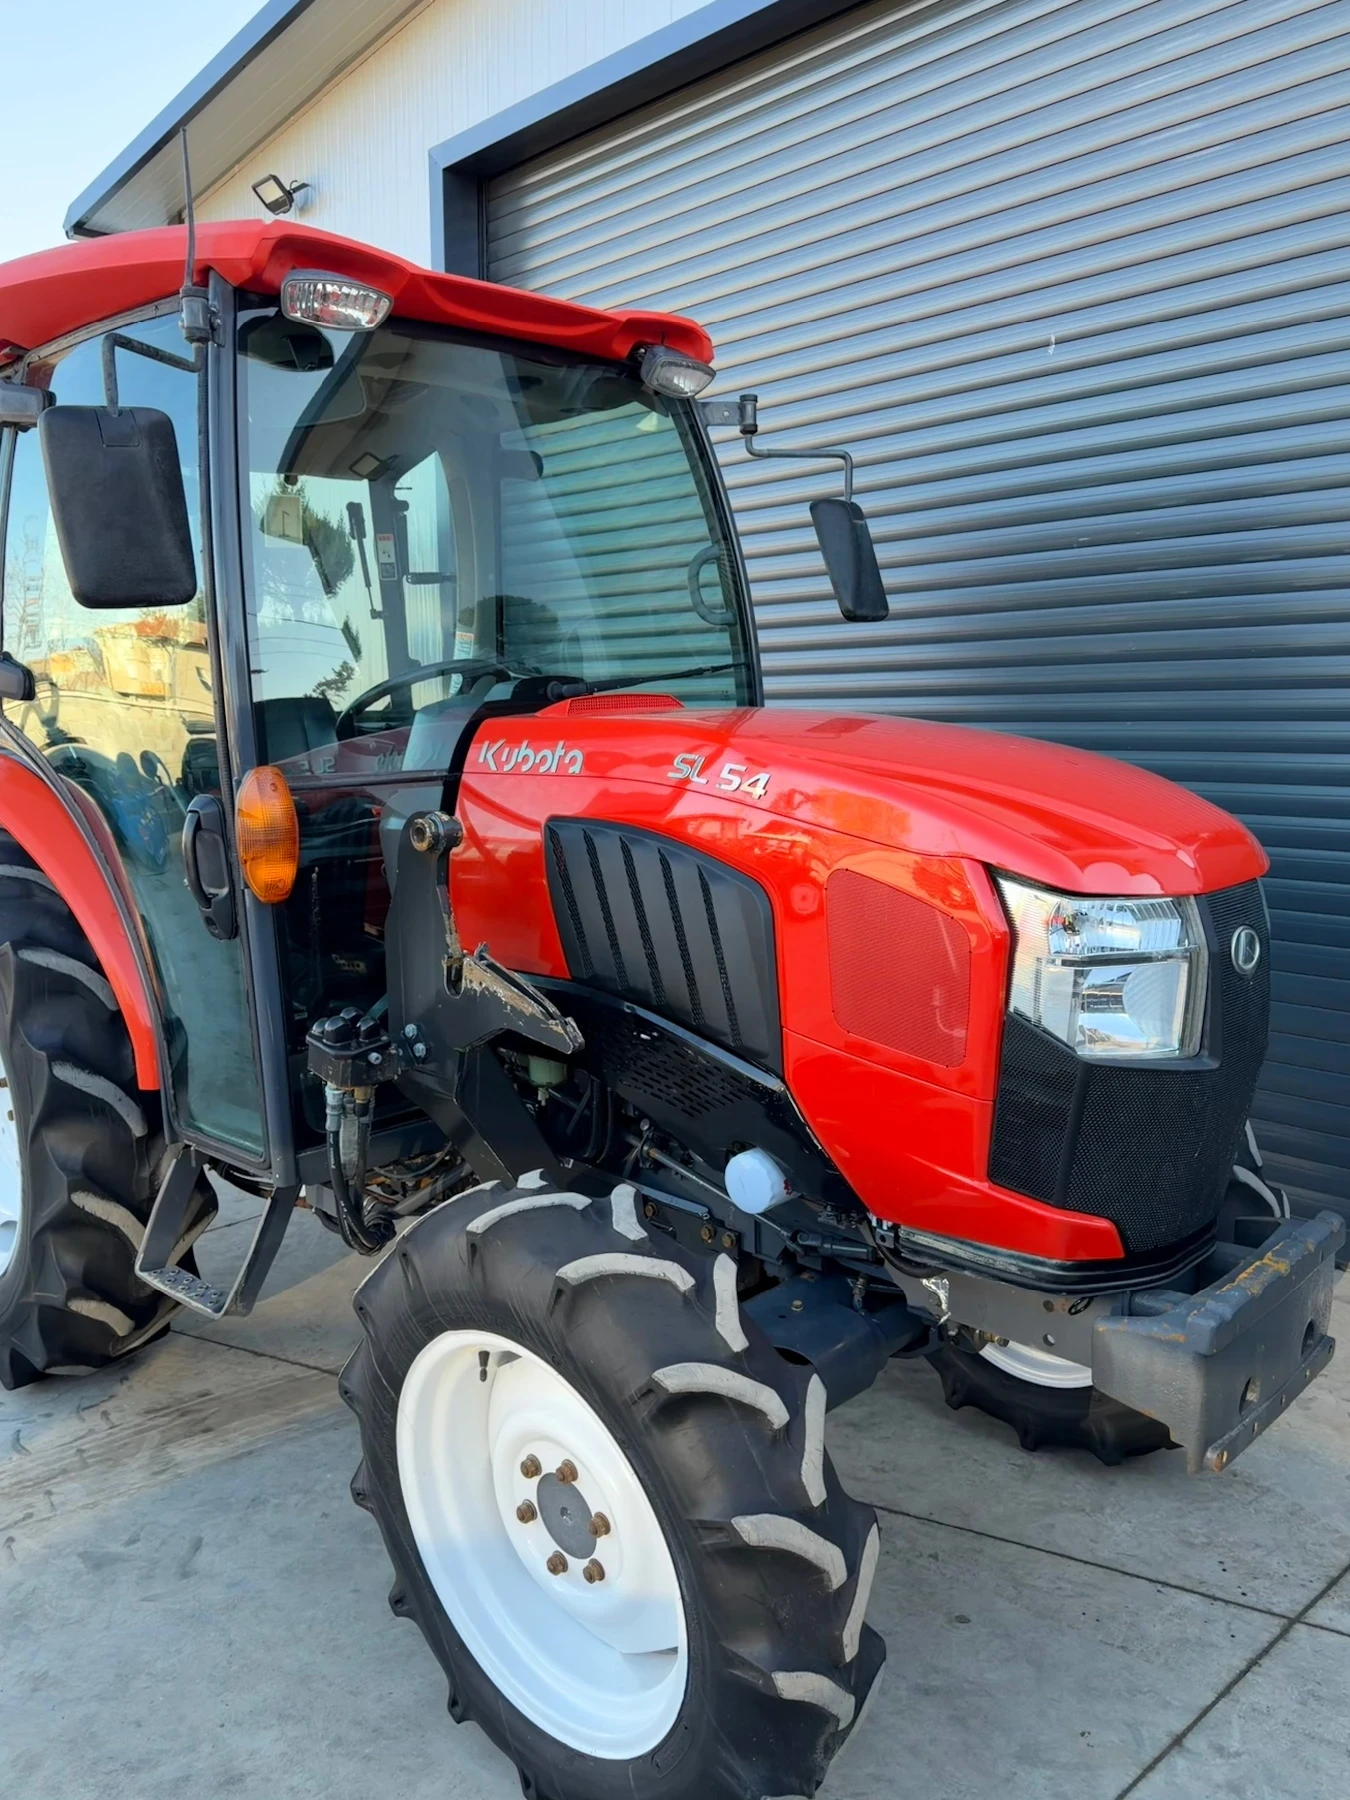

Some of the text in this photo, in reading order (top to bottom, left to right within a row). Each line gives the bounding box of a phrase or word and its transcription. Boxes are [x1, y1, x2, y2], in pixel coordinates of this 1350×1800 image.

[478, 738, 585, 774] Kubota
[667, 752, 772, 800] SL 54
